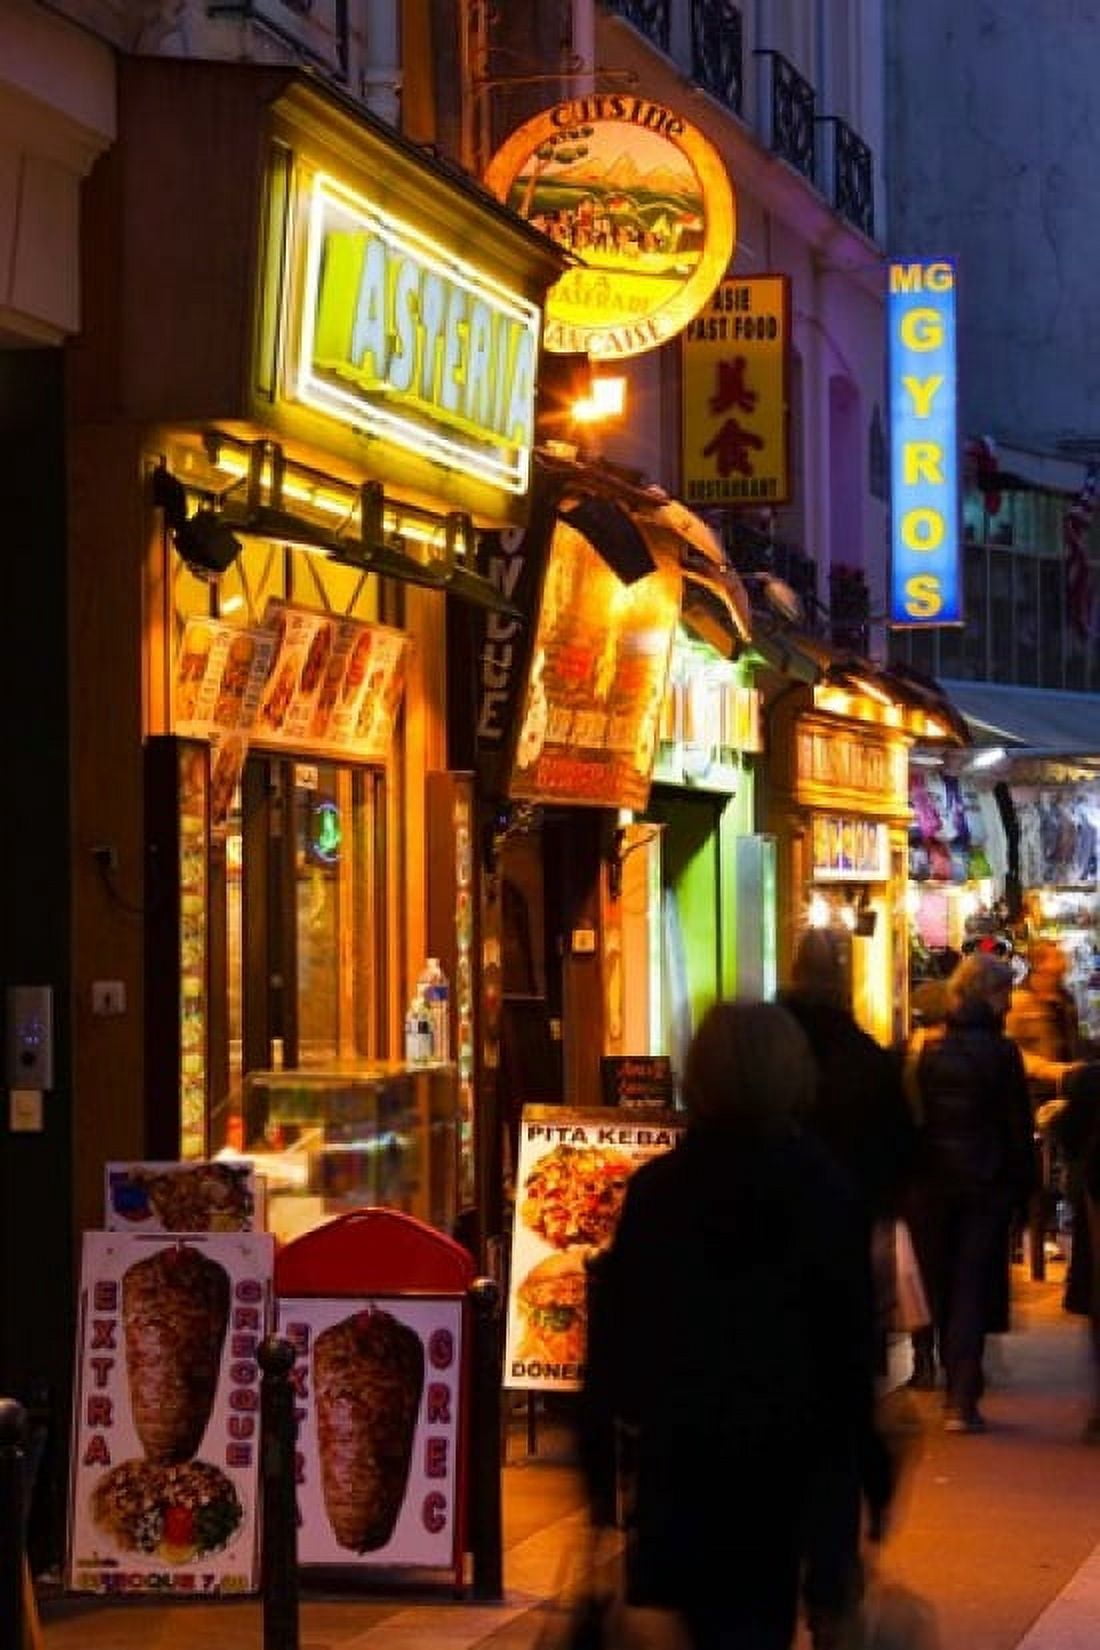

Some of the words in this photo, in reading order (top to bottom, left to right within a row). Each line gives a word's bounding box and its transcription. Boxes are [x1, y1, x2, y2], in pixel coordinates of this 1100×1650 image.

[734, 315, 778, 340] FOOD
[888, 263, 954, 293] MG
[350, 238, 536, 448] ASTERIA
[900, 307, 945, 617] GYROS
[527, 1125, 588, 1143] PITA
[84, 1281, 118, 1466] EXTRA
